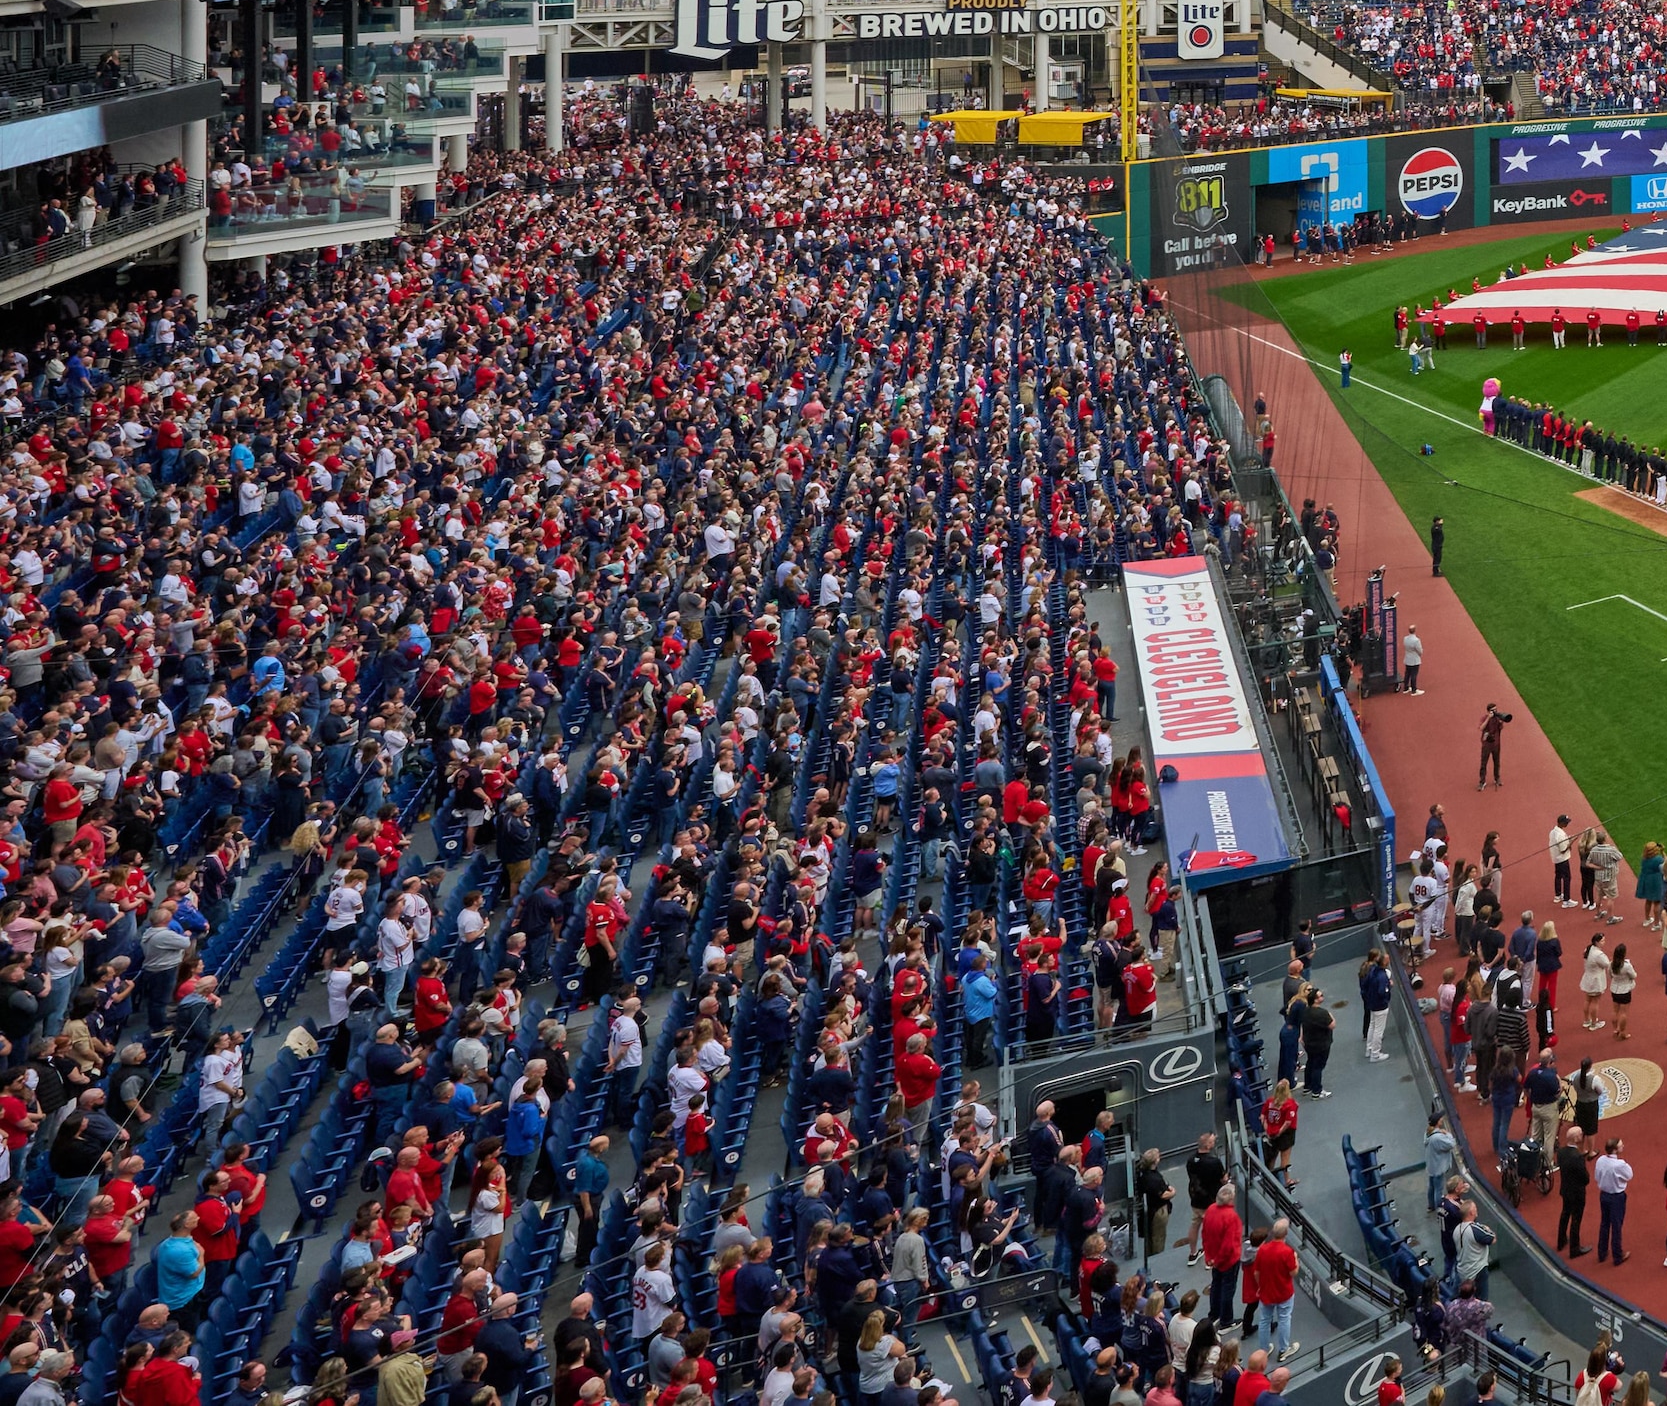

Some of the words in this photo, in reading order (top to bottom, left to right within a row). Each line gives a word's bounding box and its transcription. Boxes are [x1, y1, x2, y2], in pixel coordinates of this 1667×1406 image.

[859, 10, 995, 39] BREWED
[1000, 9, 1032, 34] IN
[1038, 7, 1107, 32] OHIO
[1181, 3, 1220, 24] Lite
[1511, 122, 1570, 135] PROGRESSIVE
[1593, 117, 1648, 129] PROGRESSIVE
[1182, 162, 1228, 175] ENBRIDGE
[1403, 173, 1459, 194] PEPSI
[1179, 178, 1221, 213] 811
[1493, 193, 1568, 214] KeyBank
[1164, 237, 1190, 254] Call
[1175, 252, 1200, 270] you
[1142, 627, 1244, 742] CLEVELAND
[1206, 790, 1236, 834] PROGRESSIVE
[1414, 883, 1427, 896] 88
[1612, 1320, 1624, 1342] 5
